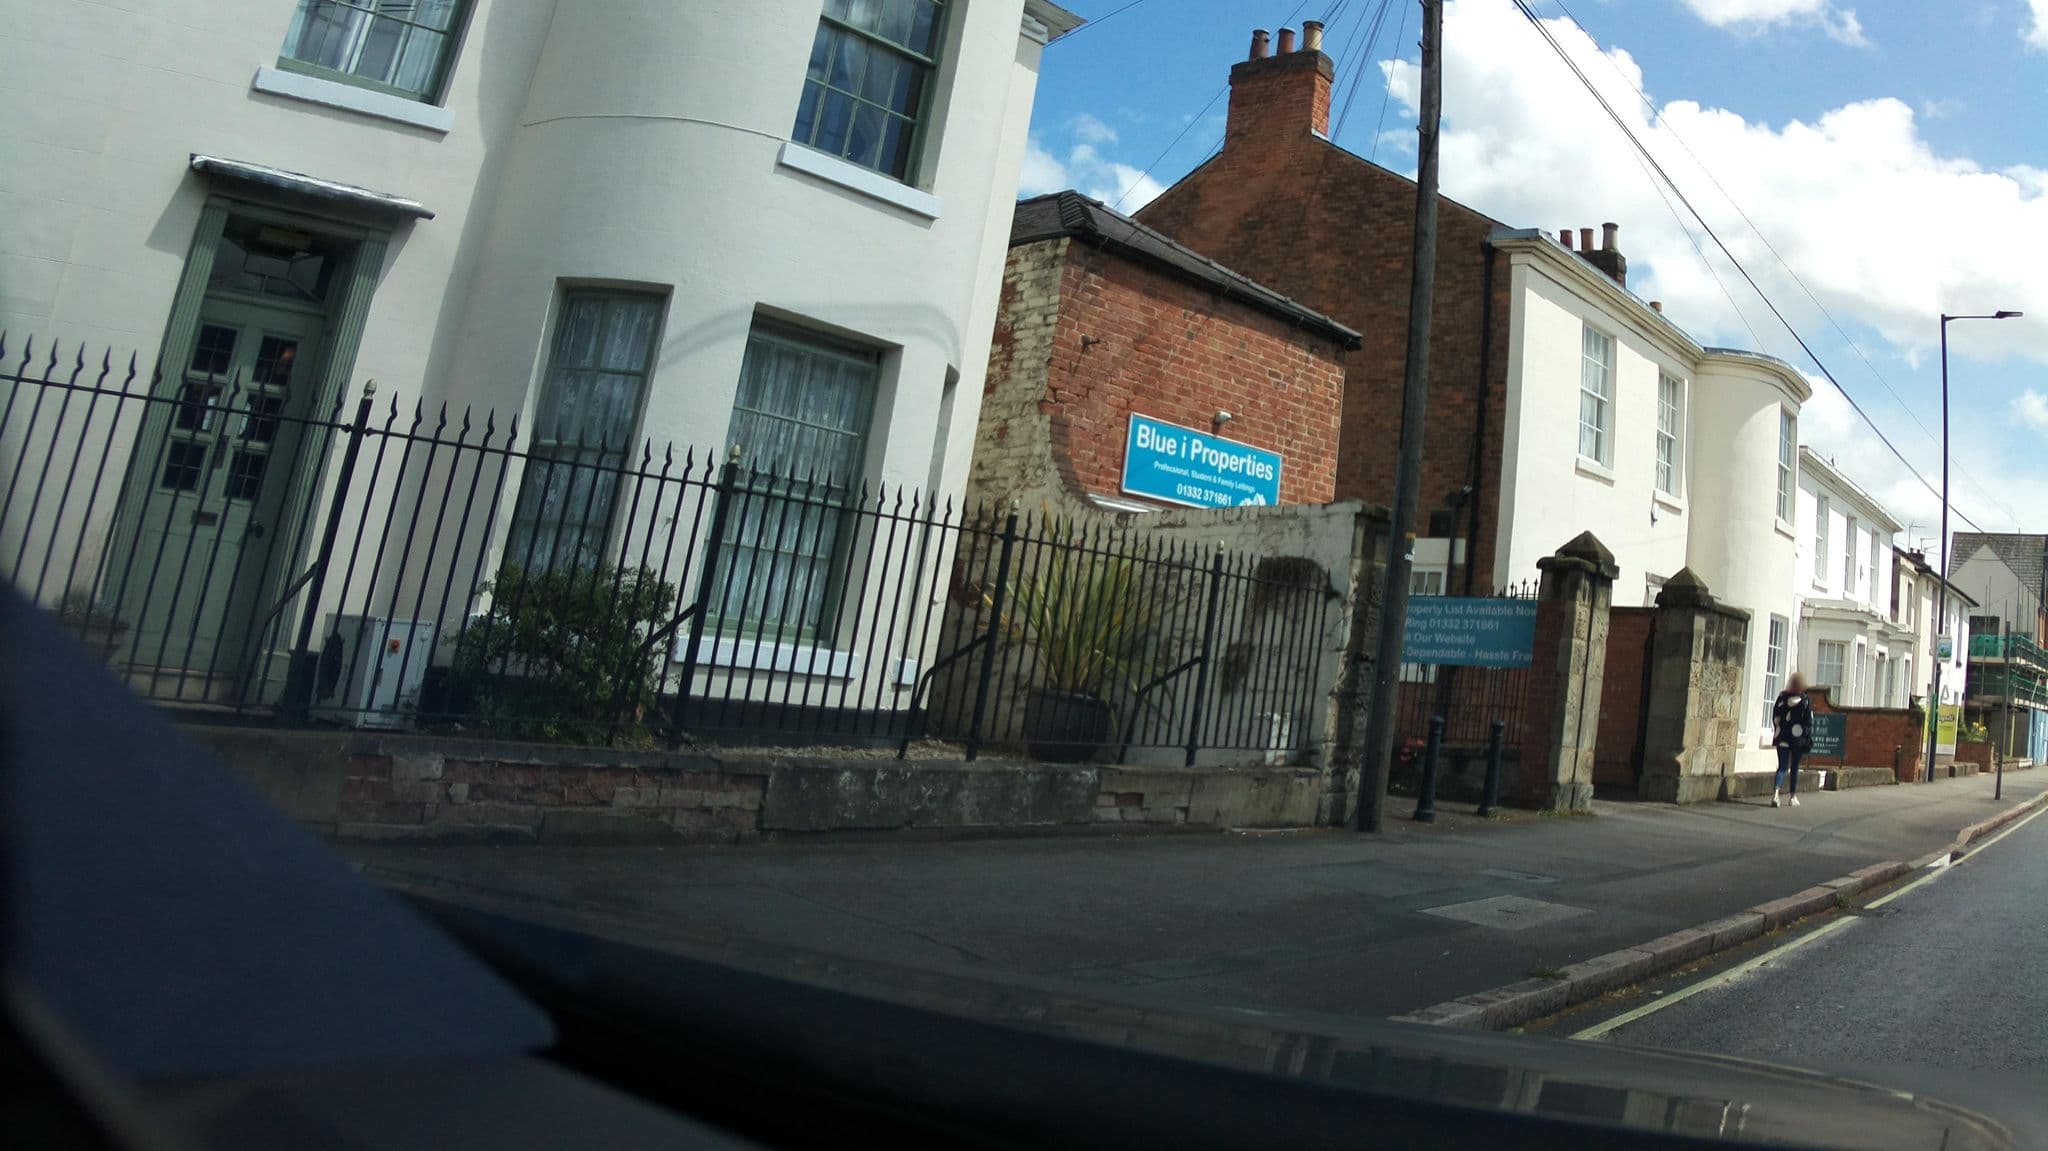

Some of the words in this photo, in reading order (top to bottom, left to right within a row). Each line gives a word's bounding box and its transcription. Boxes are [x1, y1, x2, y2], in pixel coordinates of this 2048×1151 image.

[1137, 424, 1177, 455] Blue
[1180, 436, 1187, 459] i
[1190, 438, 1273, 481] Properties
[1217, 476, 1235, 490] Family
[1176, 483, 1201, 500] 01332
[1204, 488, 1232, 507] 371661
[1406, 605, 1442, 616] roperty
[1445, 604, 1463, 615] List
[1466, 605, 1514, 616] Available
[1405, 618, 1427, 630] Ring
[1429, 619, 1460, 630] 01332
[1413, 633, 1433, 643] Our
[1434, 633, 1477, 645] Website
[1406, 647, 1466, 659] Dependable
[1474, 649, 1510, 661] Hassle
